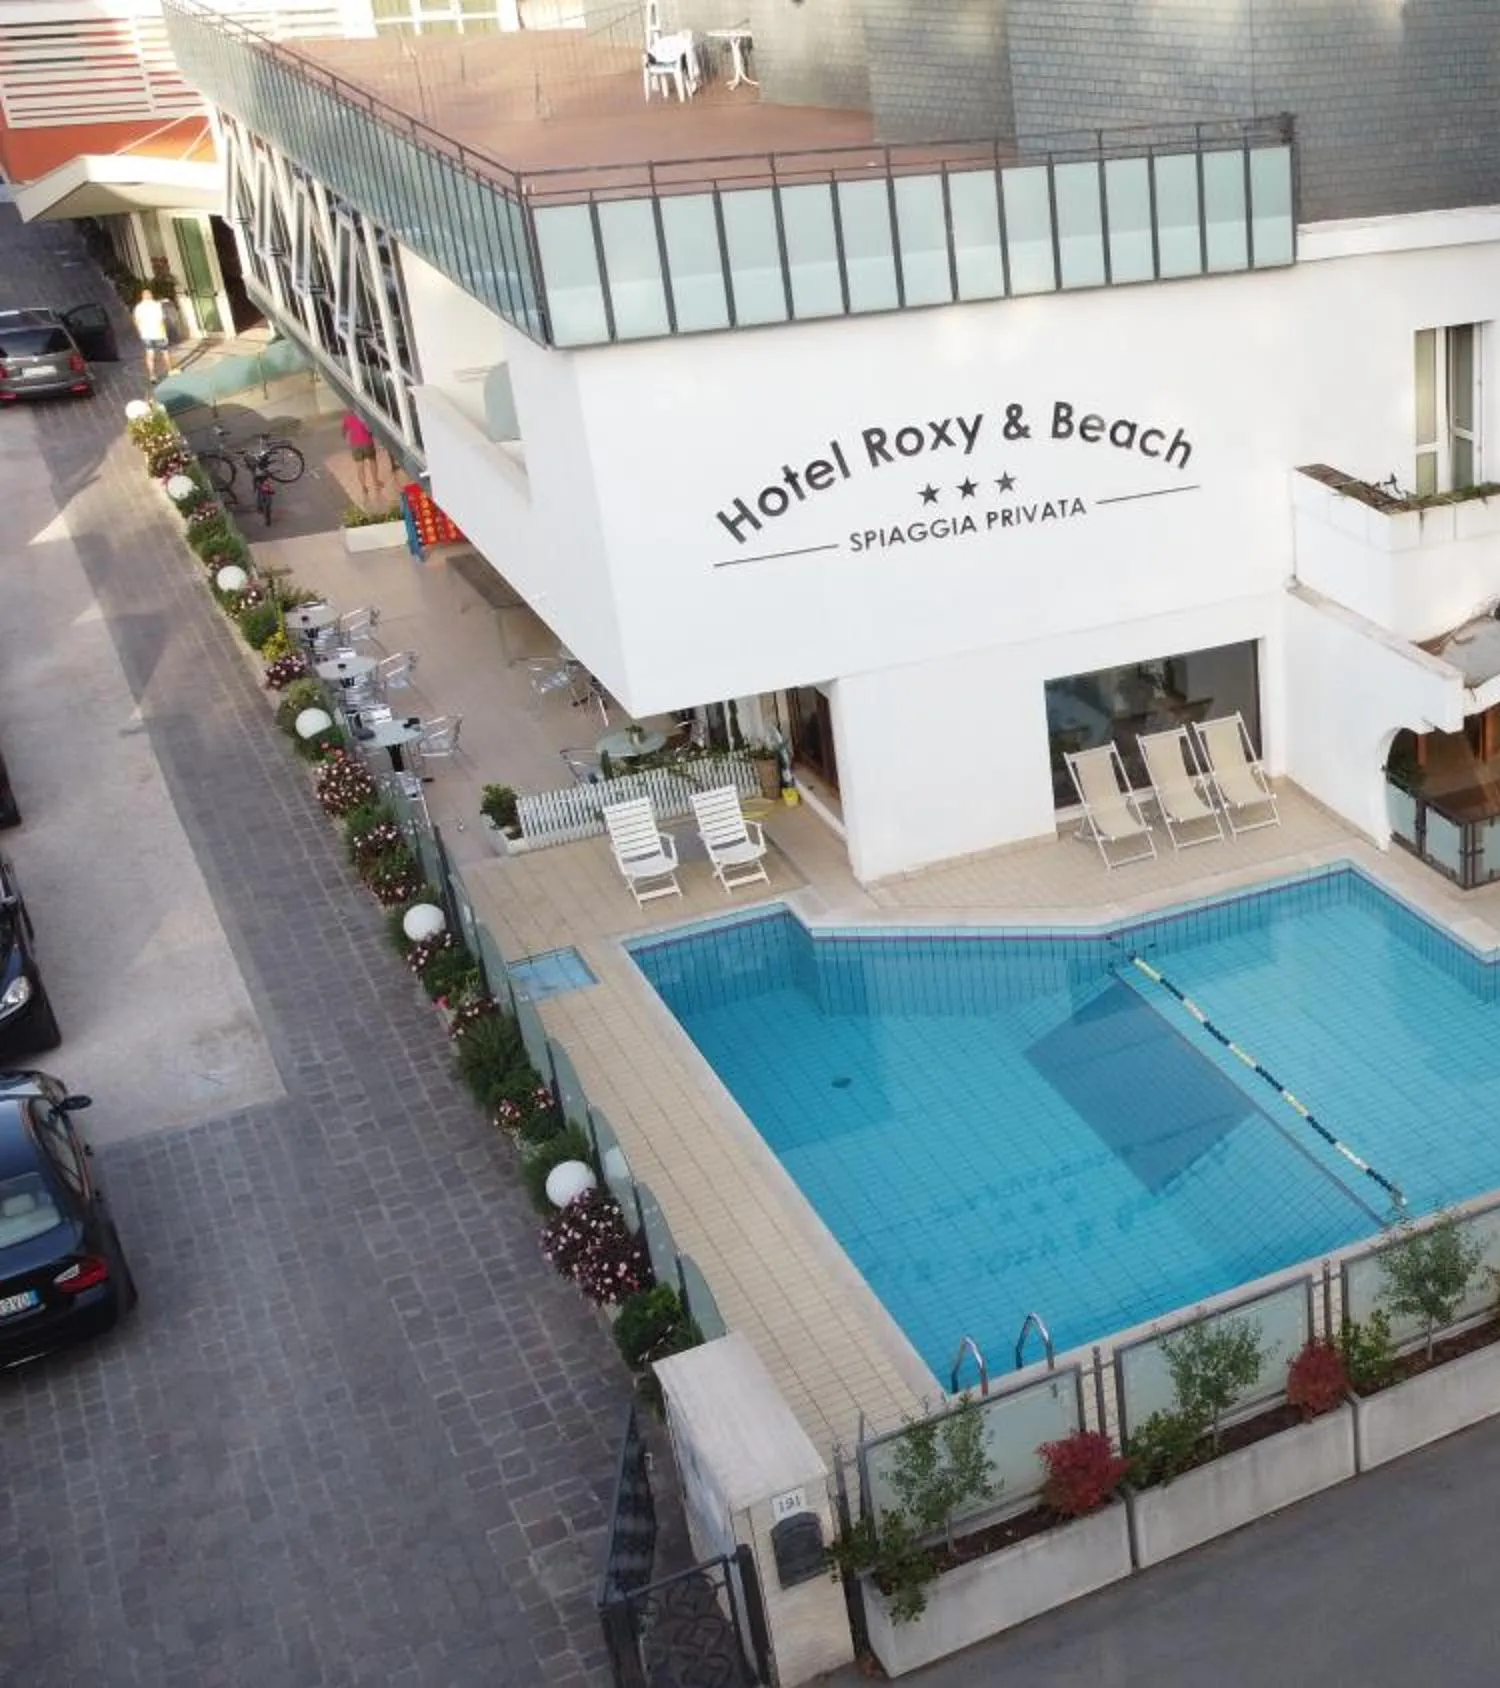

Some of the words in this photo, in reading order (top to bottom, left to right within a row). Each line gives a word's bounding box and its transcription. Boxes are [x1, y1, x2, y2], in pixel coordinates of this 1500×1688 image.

[716, 440, 851, 544] Hotel
[862, 412, 984, 469] Roxy
[1002, 402, 1032, 441] &
[1050, 400, 1194, 470] Beach
[849, 515, 978, 553] SPIAGGIA
[986, 497, 1087, 530] PRIVATA
